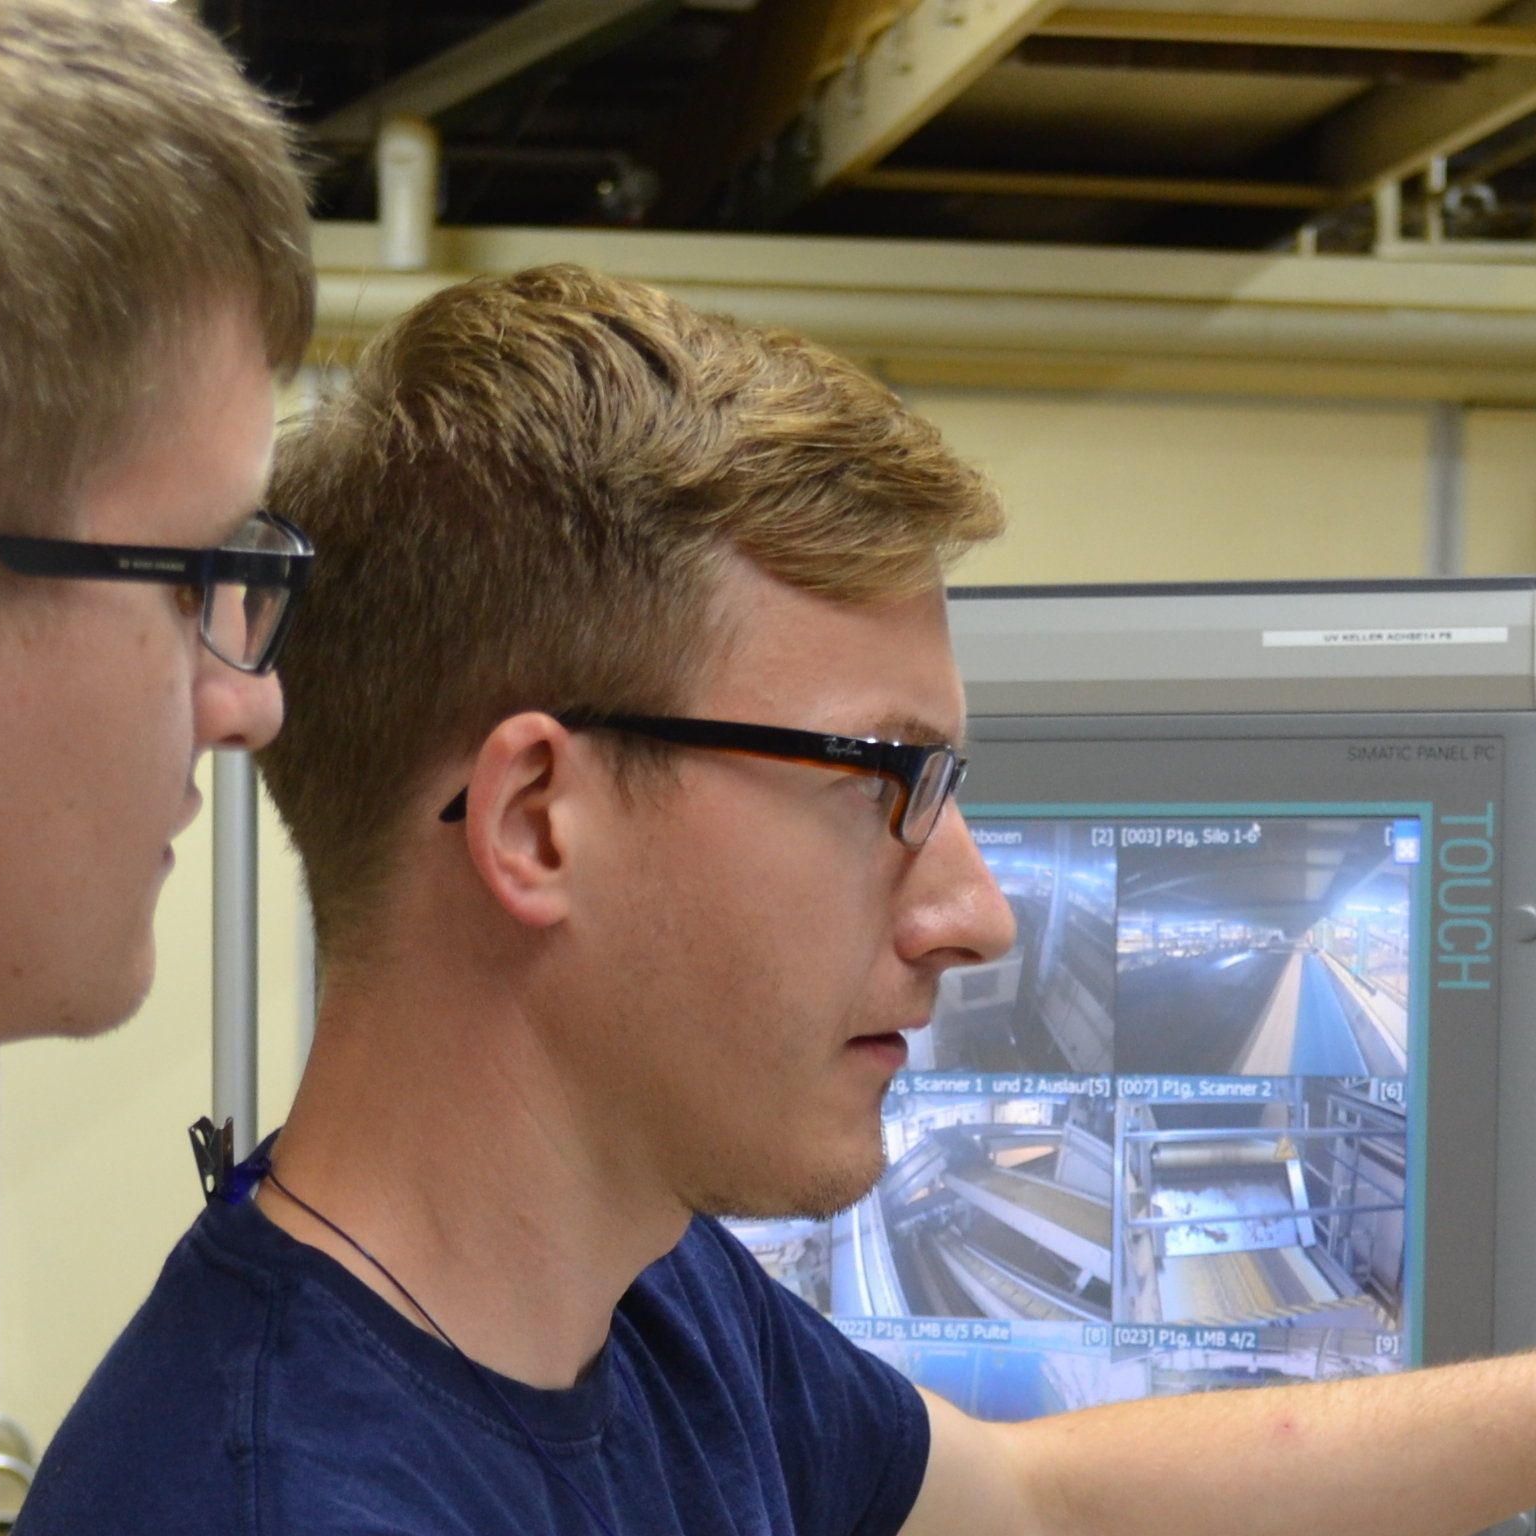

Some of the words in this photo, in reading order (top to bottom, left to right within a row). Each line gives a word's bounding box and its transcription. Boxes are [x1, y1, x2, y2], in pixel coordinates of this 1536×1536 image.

[1342, 633, 1383, 641] KELLER
[1348, 746, 1411, 761] SIMATIC
[1418, 746, 1468, 761] PANEL
[1474, 746, 1494, 761] PC
[1091, 828, 1113, 847] [2]
[1121, 828, 1162, 847] [003]
[1202, 829, 1229, 844] Silo
[1438, 802, 1494, 989] TOUCH
[914, 1077, 970, 1092] Scanner
[993, 1078, 1020, 1093] und
[1024, 1080, 1034, 1093] 2
[1118, 1079, 1158, 1099] [007]
[1200, 1081, 1257, 1096] Scanner
[1263, 1082, 1271, 1097] 2
[1381, 1082, 1403, 1100] [6]
[1115, 1327, 1154, 1347] [023]
[1196, 1331, 1226, 1347] LMB
[1230, 1332, 1255, 1348] 4/2
[1376, 1334, 1399, 1355] [9]
